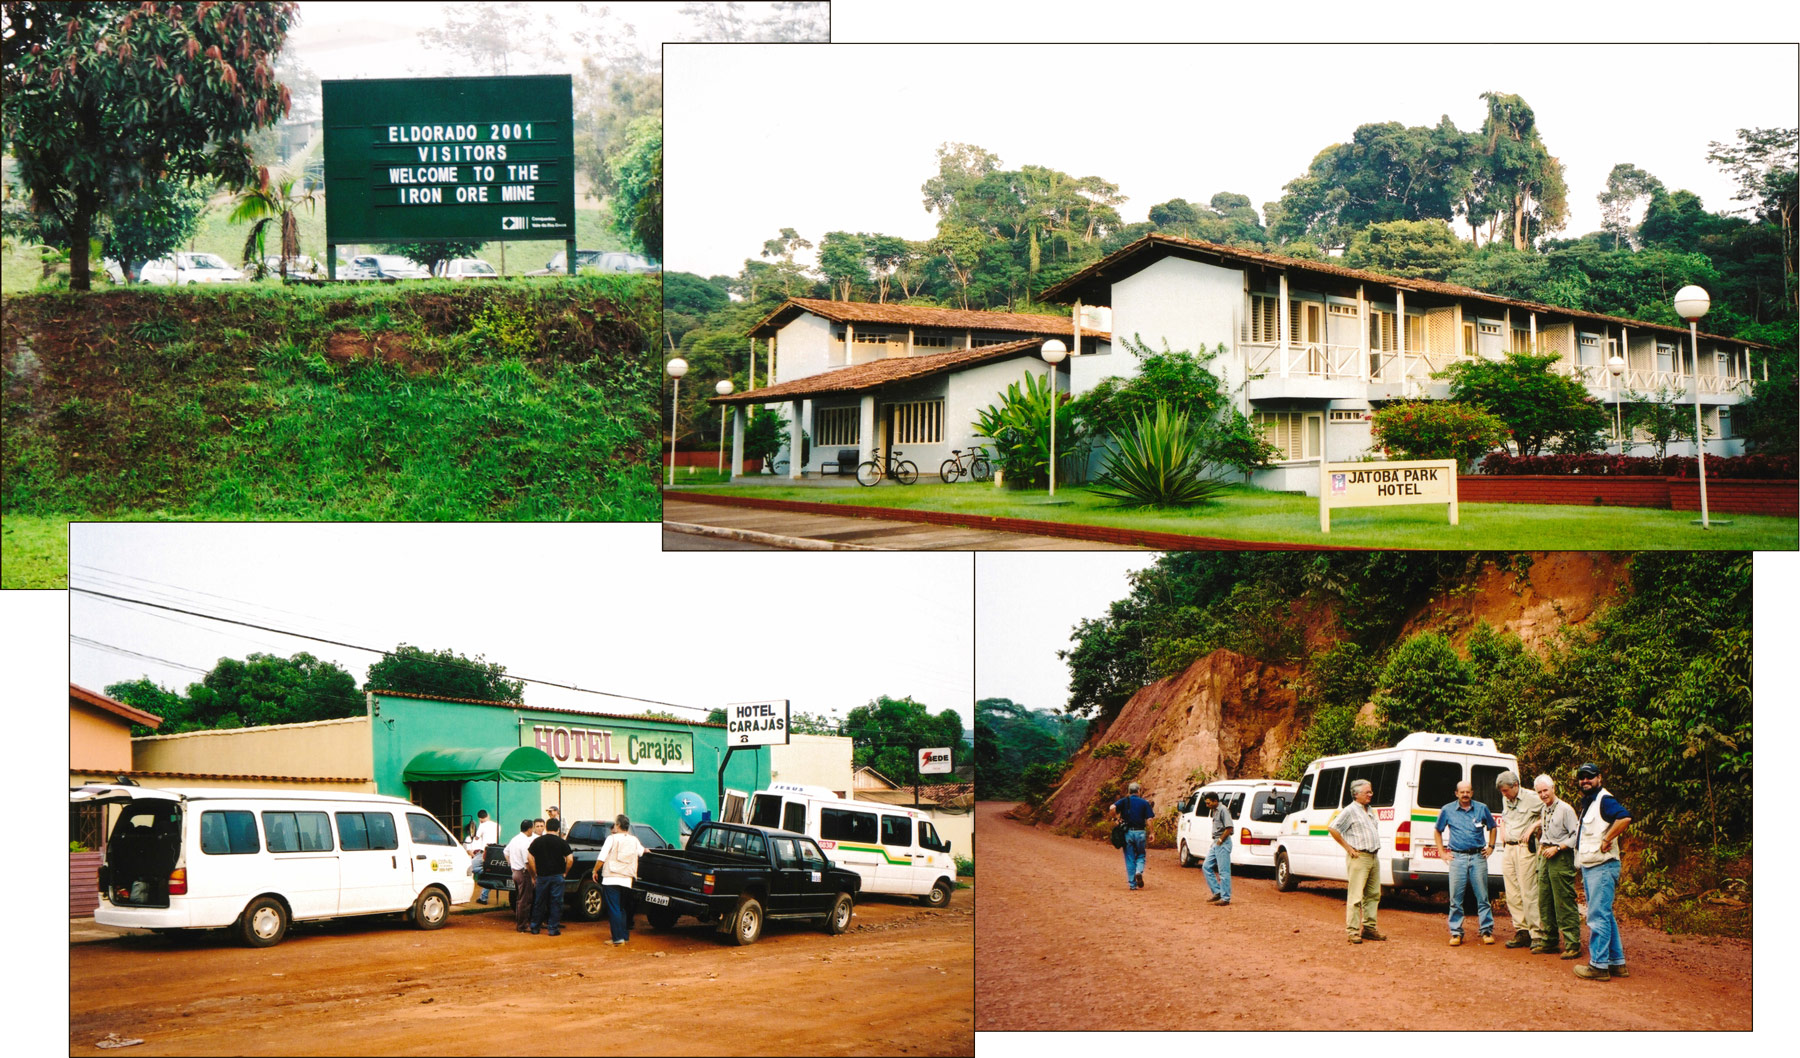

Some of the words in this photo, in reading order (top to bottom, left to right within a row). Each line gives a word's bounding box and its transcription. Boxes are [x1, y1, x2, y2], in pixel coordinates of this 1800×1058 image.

[388, 124, 478, 142] ELDORADO
[491, 123, 533, 140] 2001
[418, 145, 507, 162] VISITORS
[389, 166, 458, 184] WELCOME
[473, 166, 495, 182] TO
[507, 164, 539, 181] THE
[401, 187, 442, 204] IRON
[456, 186, 488, 202] ORE
[502, 185, 535, 201] MINE
[1404, 469, 1438, 482] PARK
[1378, 483, 1422, 496] HOTEL
[736, 704, 776, 718] HOTEL
[729, 716, 784, 733] CARAJÁS
[533, 725, 620, 764] HOTEL
[628, 734, 682, 766] Carajás
[1434, 736, 1484, 747] JESUS
[927, 754, 949, 762] REDE
[774, 784, 804, 792] JESUS
[1380, 810, 1393, 820] 6038
